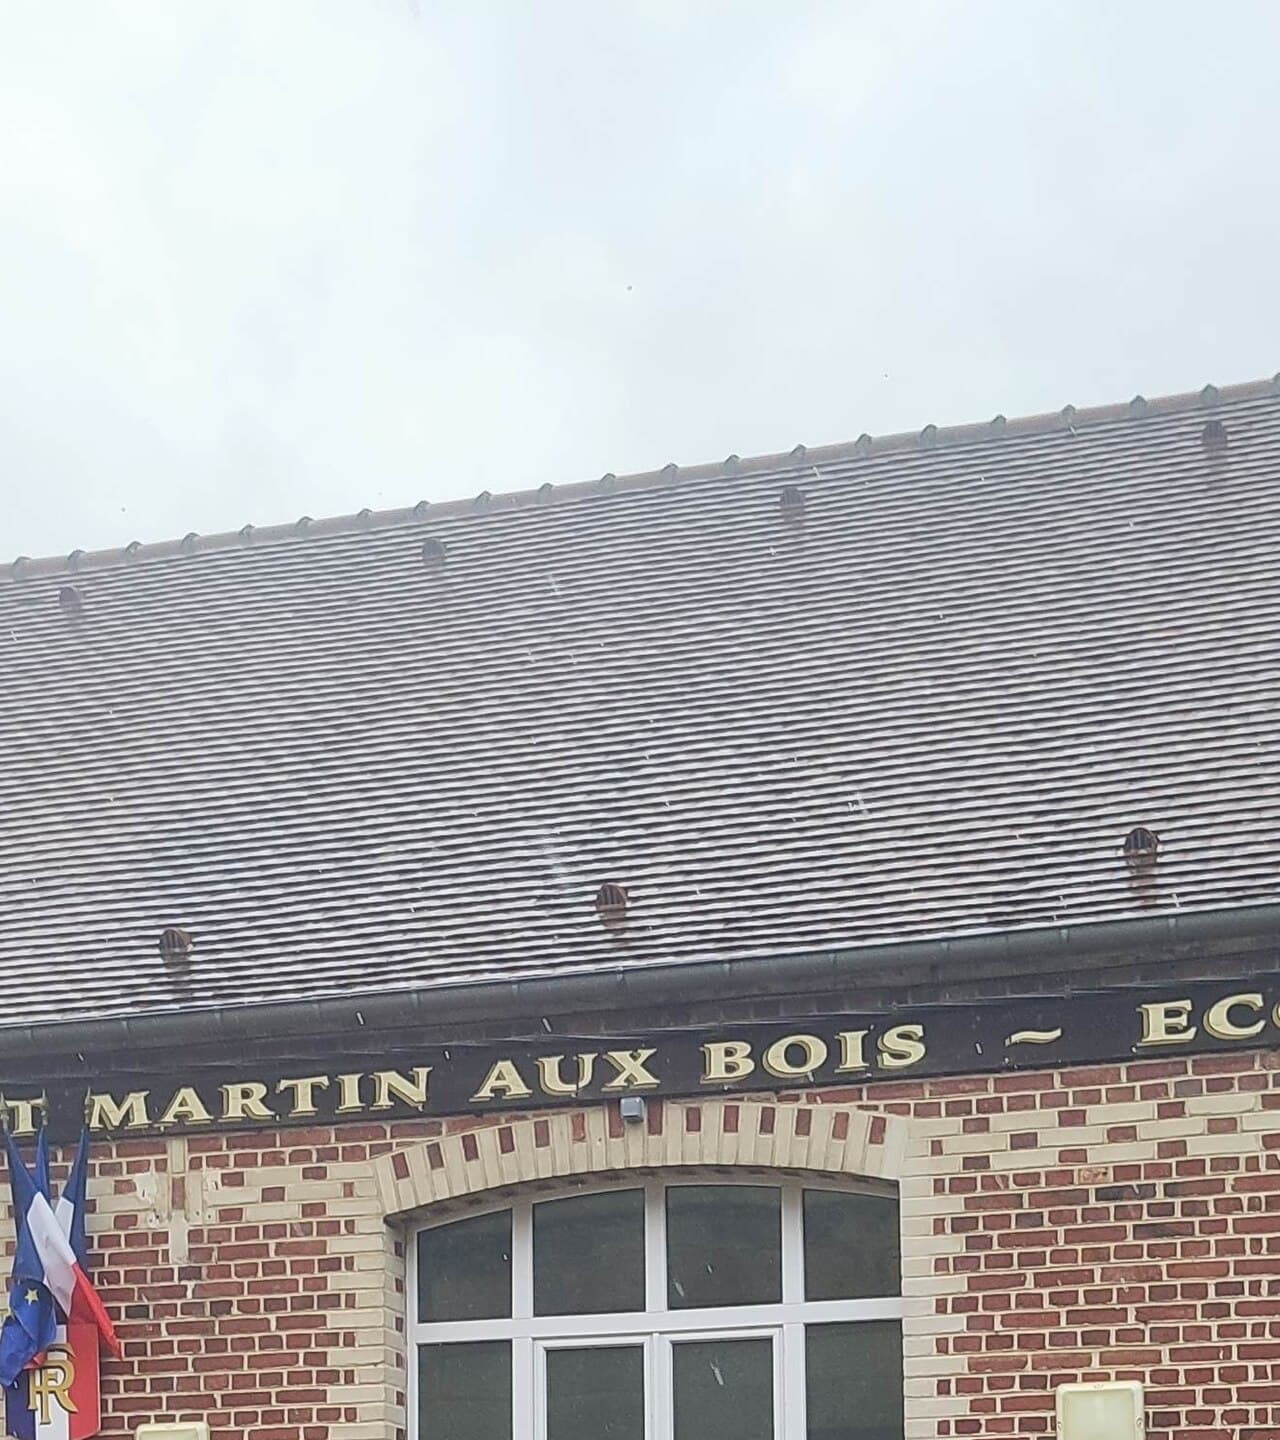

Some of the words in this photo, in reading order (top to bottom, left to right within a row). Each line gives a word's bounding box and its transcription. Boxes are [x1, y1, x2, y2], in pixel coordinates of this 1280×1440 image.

[89, 1066, 433, 1132] MARTIN
[469, 1048, 660, 1103] AUX
[701, 1024, 926, 1083] BOIS
